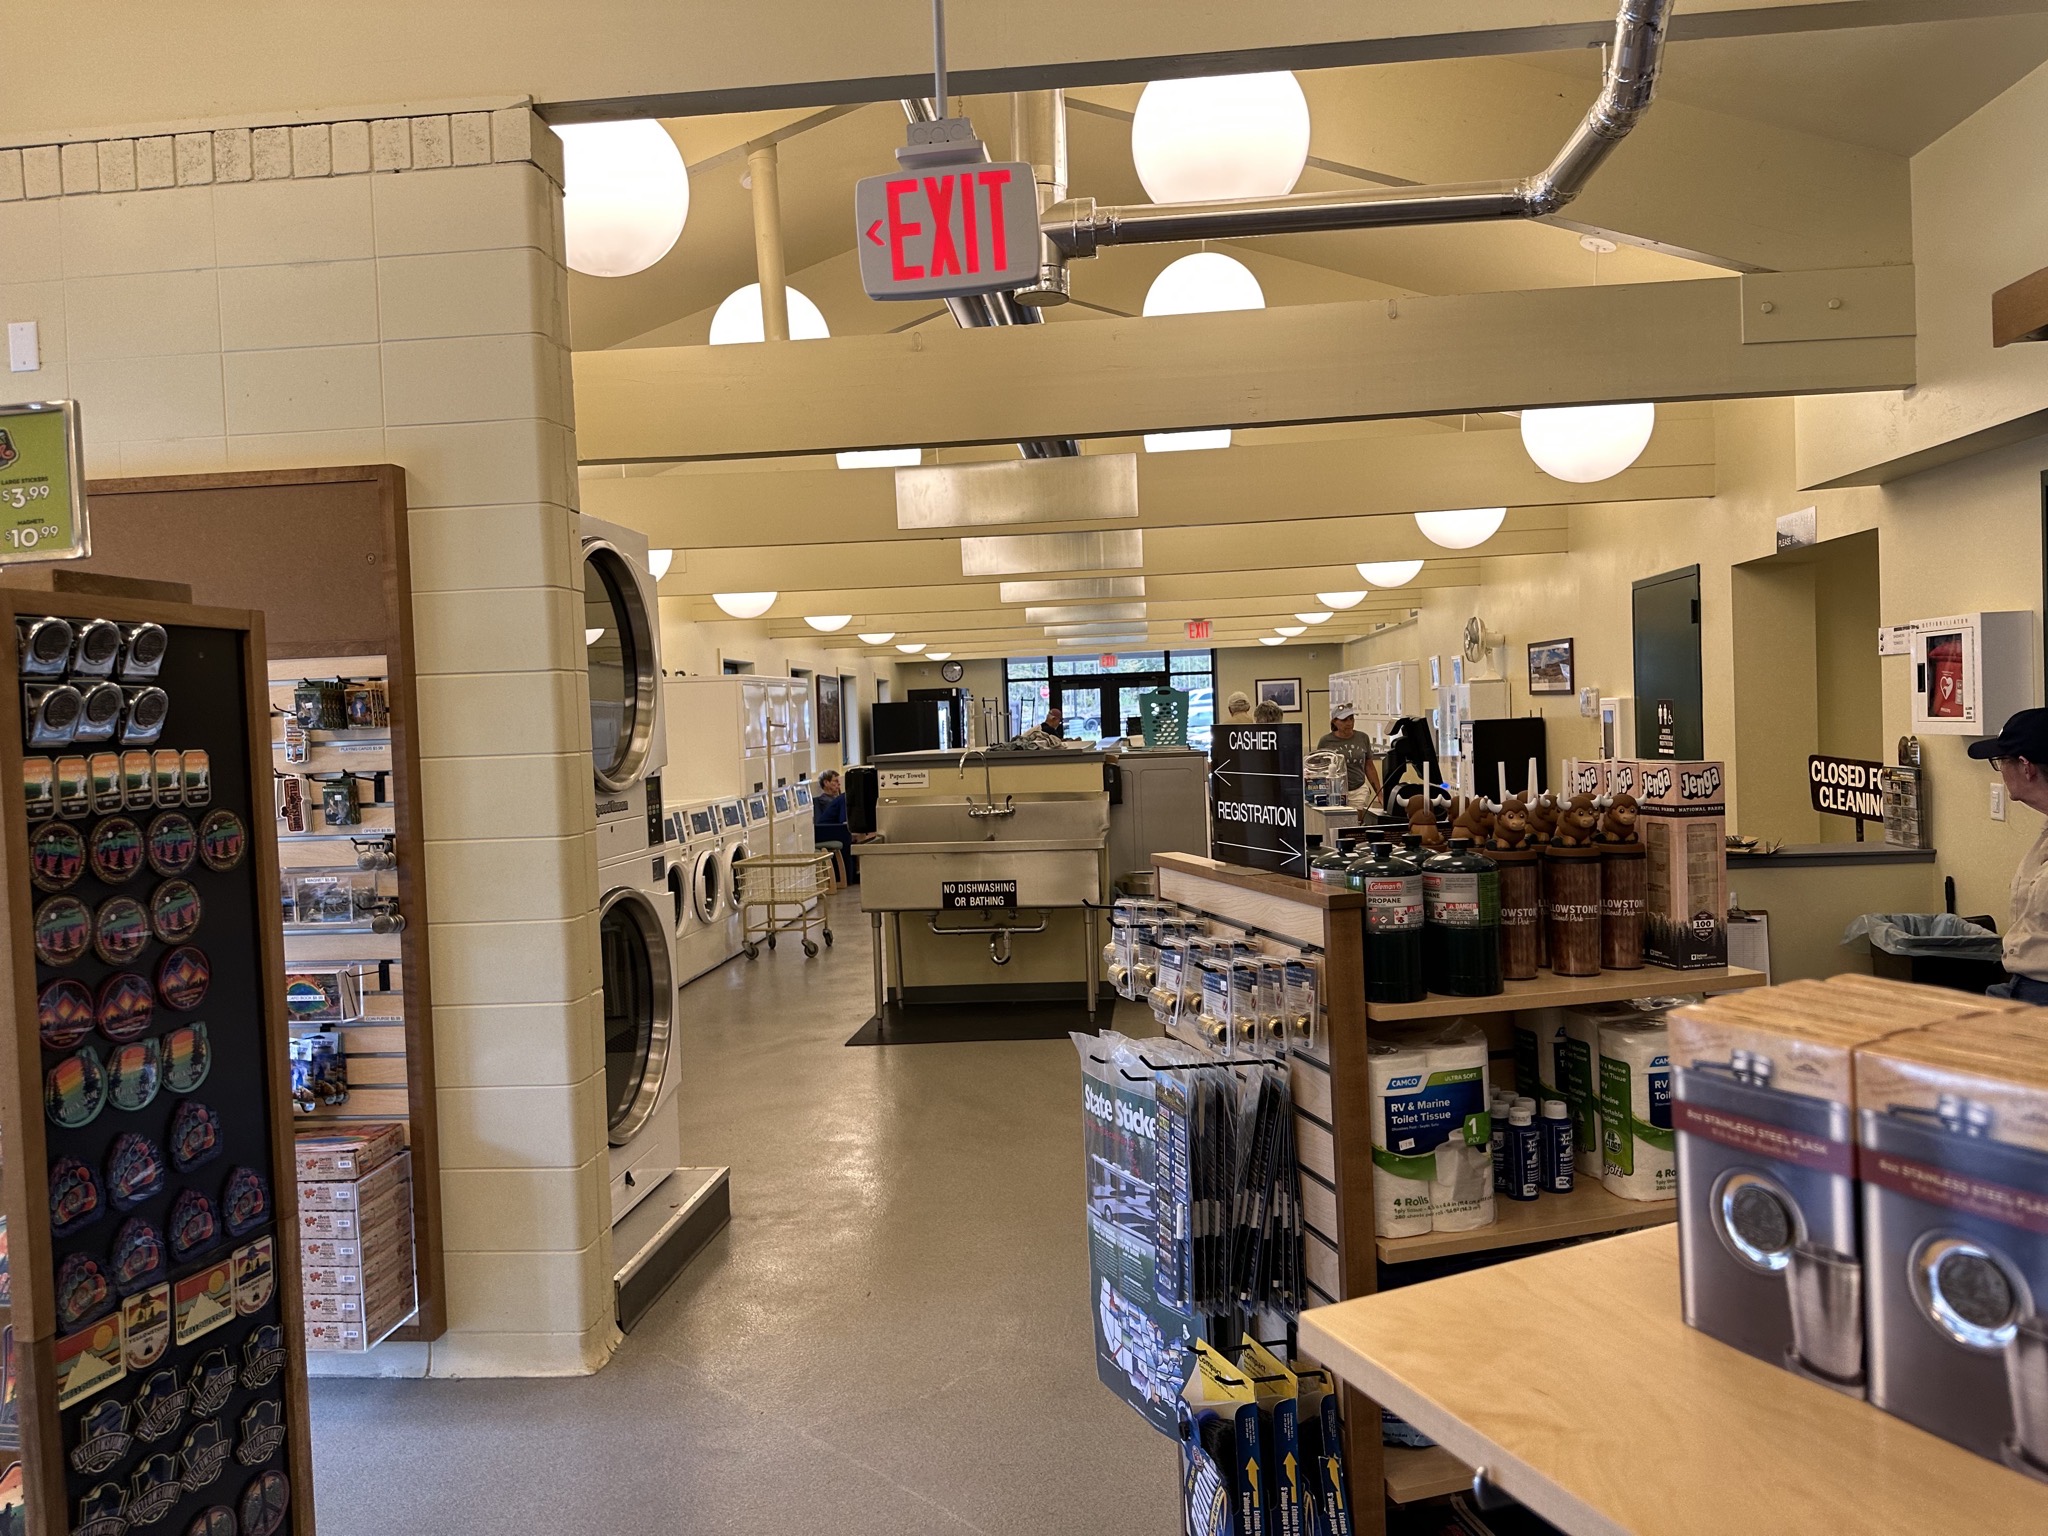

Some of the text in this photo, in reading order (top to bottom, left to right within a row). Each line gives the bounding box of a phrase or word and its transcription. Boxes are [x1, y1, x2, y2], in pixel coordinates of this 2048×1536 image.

[886, 169, 1012, 282] EXIT
[2, 485, 49, 508] $3.99
[5, 526, 58, 548] $10.99
[1189, 622, 1210, 638] EXIT
[1229, 730, 1277, 750] CASHIER
[1606, 766, 1633, 794] Jnga
[1642, 767, 1671, 796] Jenga
[1682, 767, 1720, 799] Jenga
[1811, 760, 1883, 790] CLOSED FO
[1819, 785, 1884, 817] CLEANIN
[1218, 801, 1297, 828] REGISTRATION
[943, 882, 1015, 894] NO DISHWASHING
[1370, 882, 1396, 891] Coleman
[954, 896, 1004, 907] OR BATHING
[1463, 1072, 1477, 1080] SOFT
[1608, 1065, 1626, 1075] Marine
[1610, 1072, 1627, 1082] Tissue
[1391, 1078, 1418, 1087] CAMCO
[1654, 1080, 1668, 1089] RV
[1391, 1099, 1450, 1113] RV & Marine
[1655, 1092, 1671, 1100] Toil
[1085, 1083, 1156, 1141] State Sticke
[1391, 1112, 1451, 1124] Toilet Tissue
[1468, 1118, 1477, 1135] 1
[1704, 1113, 1755, 1136] STAINLESS
[1758, 1128, 1790, 1145] STEEL
[1793, 1138, 1828, 1155] FLASK
[1656, 1171, 1663, 1179] 4
[1394, 1196, 1429, 1206] 4 Rolls
[239, 1273, 272, 1293] YELLOWSTONE
[128, 1324, 168, 1344] YELLOWSTONE
[245, 1350, 285, 1385] YELLOWSTONE
[1199, 1355, 1222, 1377] Compact
[1244, 1350, 1266, 1373] Compact
[195, 1366, 237, 1413] YELLOWSTONE
[140, 1390, 188, 1437] YELLOWSTONE
[78, 1434, 130, 1467] YELLOWSTONE
[244, 1426, 284, 1460] YELLOWSTONE
[186, 1440, 230, 1485] YELLOWSTONE
[129, 1483, 180, 1522] YELLOWSTONE
[1291, 1505, 1299, 1525] Extends
[1339, 1512, 1348, 1535] Extends
[1330, 1519, 1340, 1536] jusqu'
